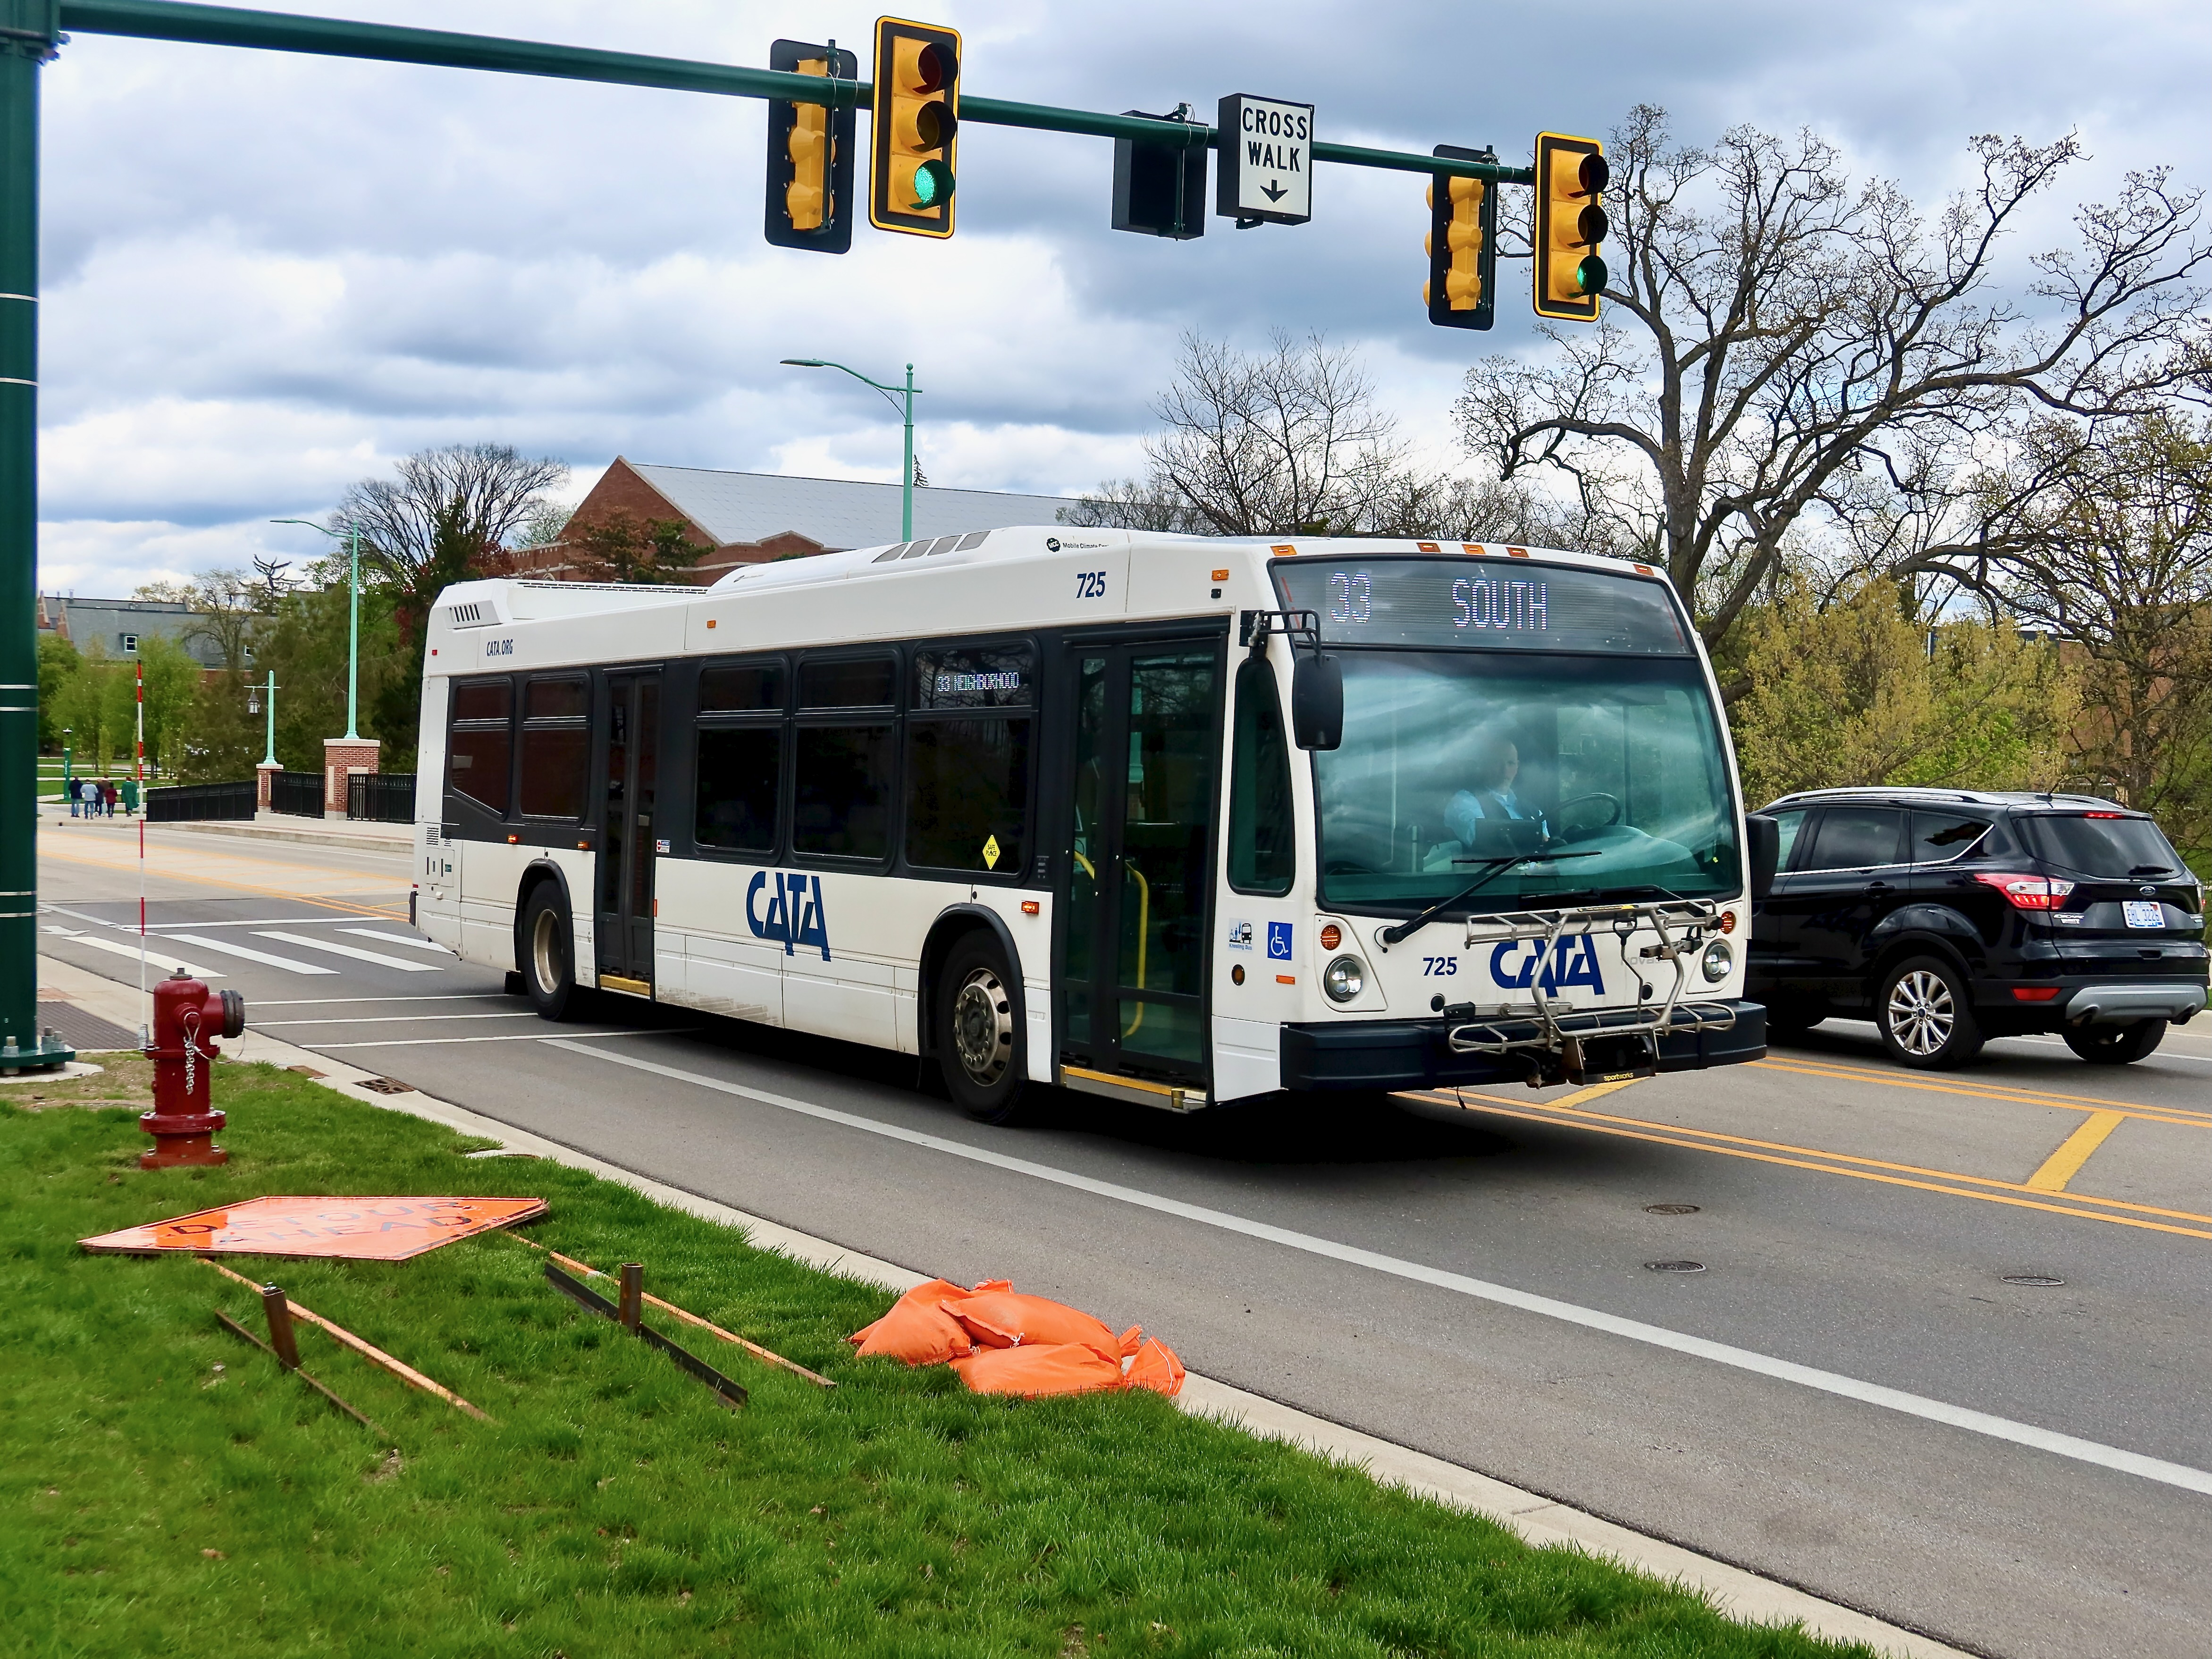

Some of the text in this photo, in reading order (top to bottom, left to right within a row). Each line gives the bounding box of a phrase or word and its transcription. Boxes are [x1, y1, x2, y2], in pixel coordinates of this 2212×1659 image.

[1242, 107, 1307, 140] CROSS
[1247, 141, 1300, 172] WALK
[1077, 572, 1106, 598] 725
[1331, 573, 1547, 630] 33 SOUTH
[487, 639, 513, 657] CATA.ORG
[937, 676, 950, 691] 33
[746, 871, 831, 962] CATA
[1423, 957, 1457, 976] 725
[1490, 935, 1606, 997] CATA
[169, 1202, 464, 1234] DETOUR
[218, 1216, 472, 1246] AHEAD
